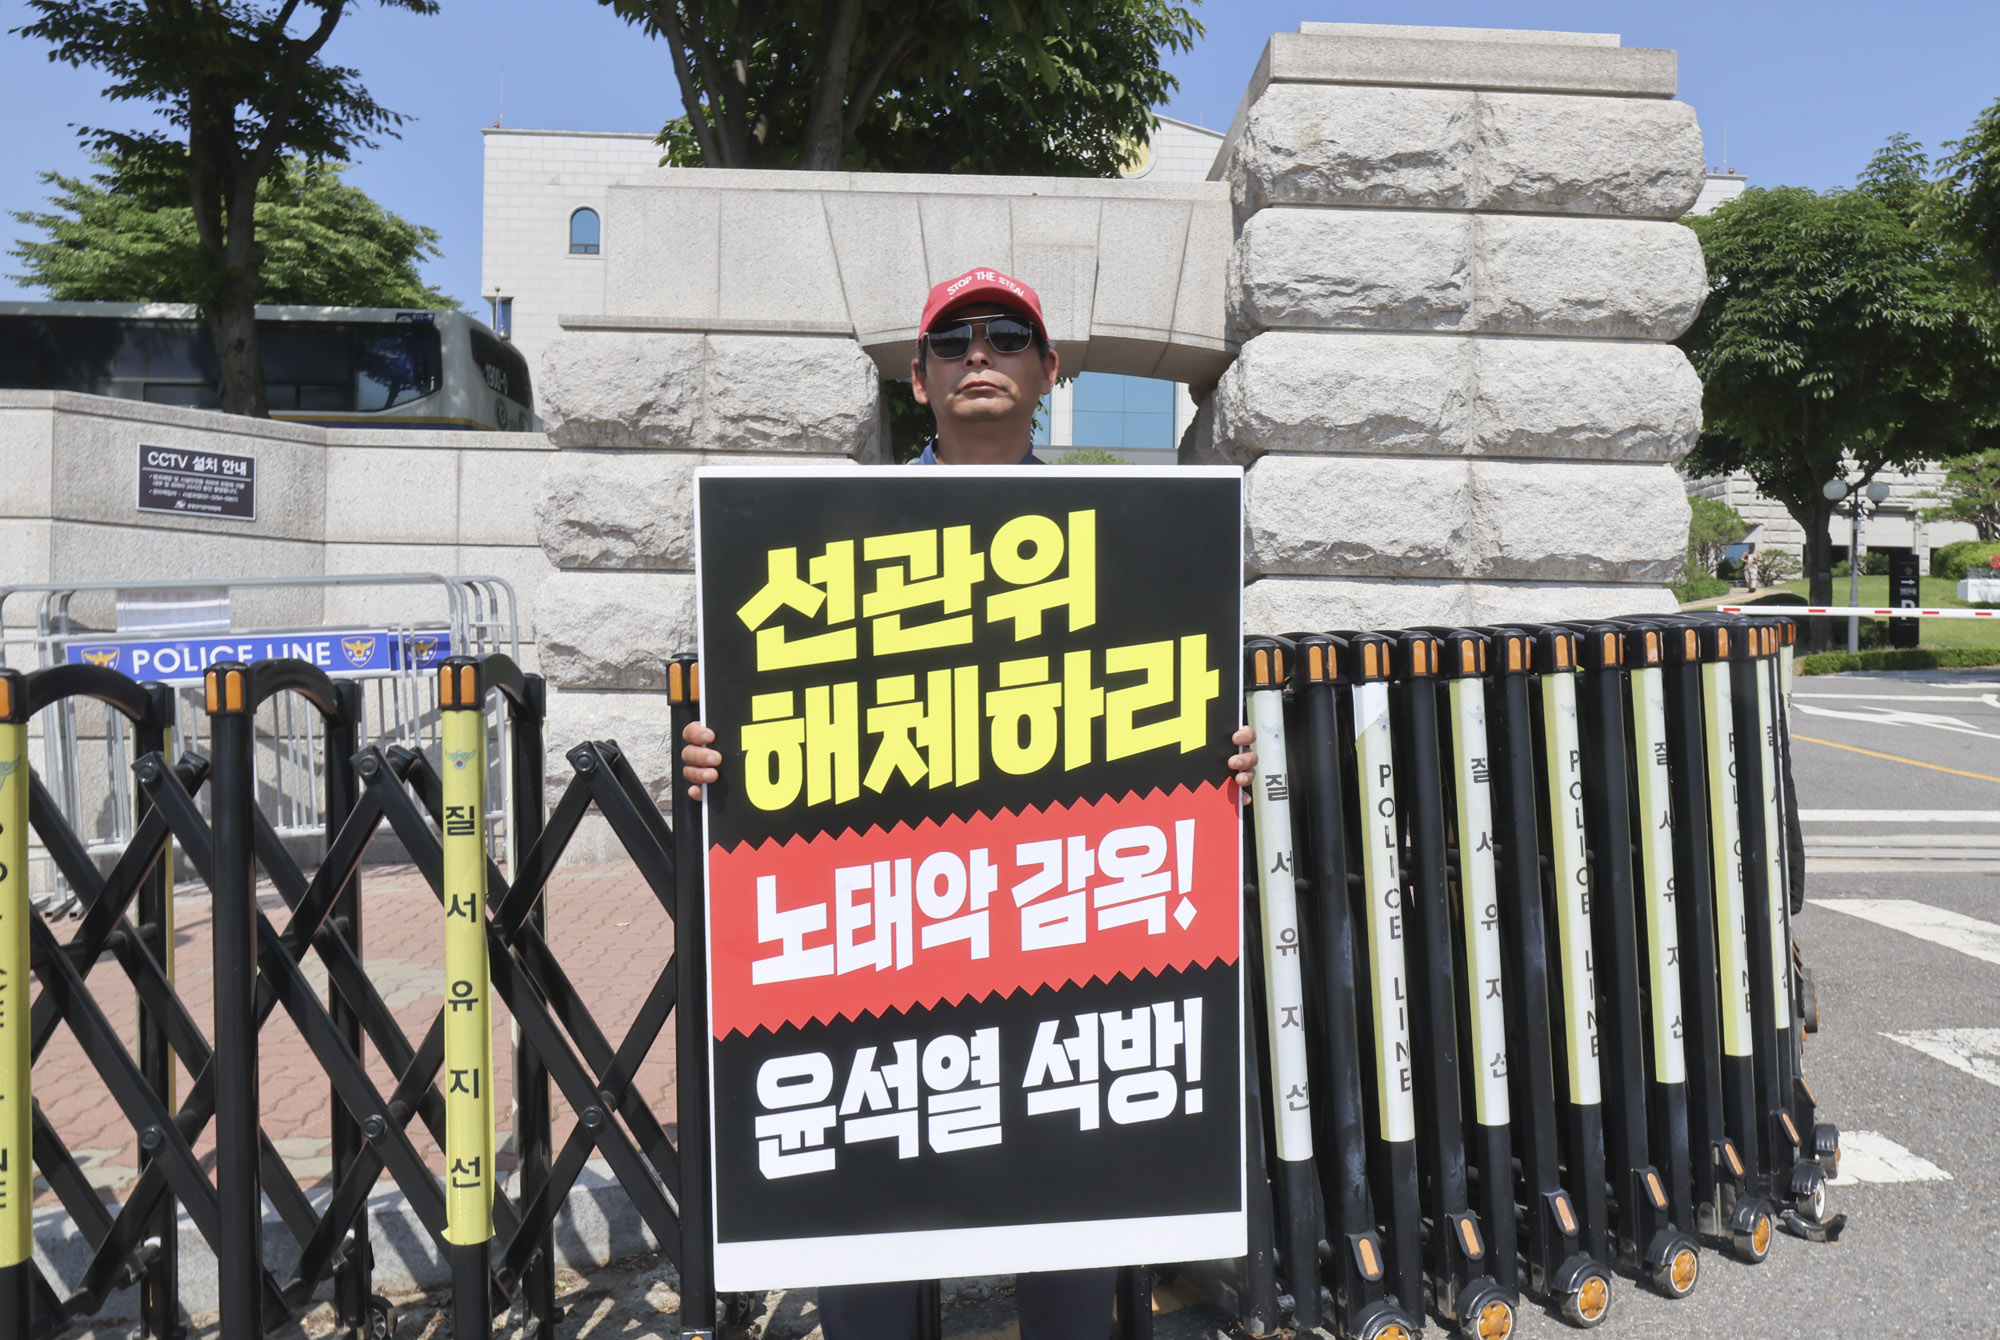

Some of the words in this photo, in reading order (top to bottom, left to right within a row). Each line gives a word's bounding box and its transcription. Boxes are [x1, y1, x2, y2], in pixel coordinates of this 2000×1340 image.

[947, 276, 973, 296] STOP
[974, 271, 996, 282] THE
[147, 451, 189, 469] CCTV
[192, 455, 218, 473] 설치
[221, 459, 247, 477] 안내
[132, 645, 253, 674] POLICE
[266, 641, 331, 665] LINE
[736, 509, 1096, 672] 선관위
[741, 633, 1220, 811] 해체하라
[752, 847, 998, 985] 노태악
[1011, 818, 1197, 951] 감옥!
[1265, 773, 1310, 1112] 질서유지선
[1378, 763, 1402, 940] POLICE
[1394, 977, 1411, 1093] LINE
[1569, 750, 1590, 915] POLICE
[1585, 950, 1599, 1058] LINE
[445, 805, 481, 1189] 질서유지선
[755, 1026, 1002, 1179] 윤석열
[1022, 996, 1203, 1131] 석방!
